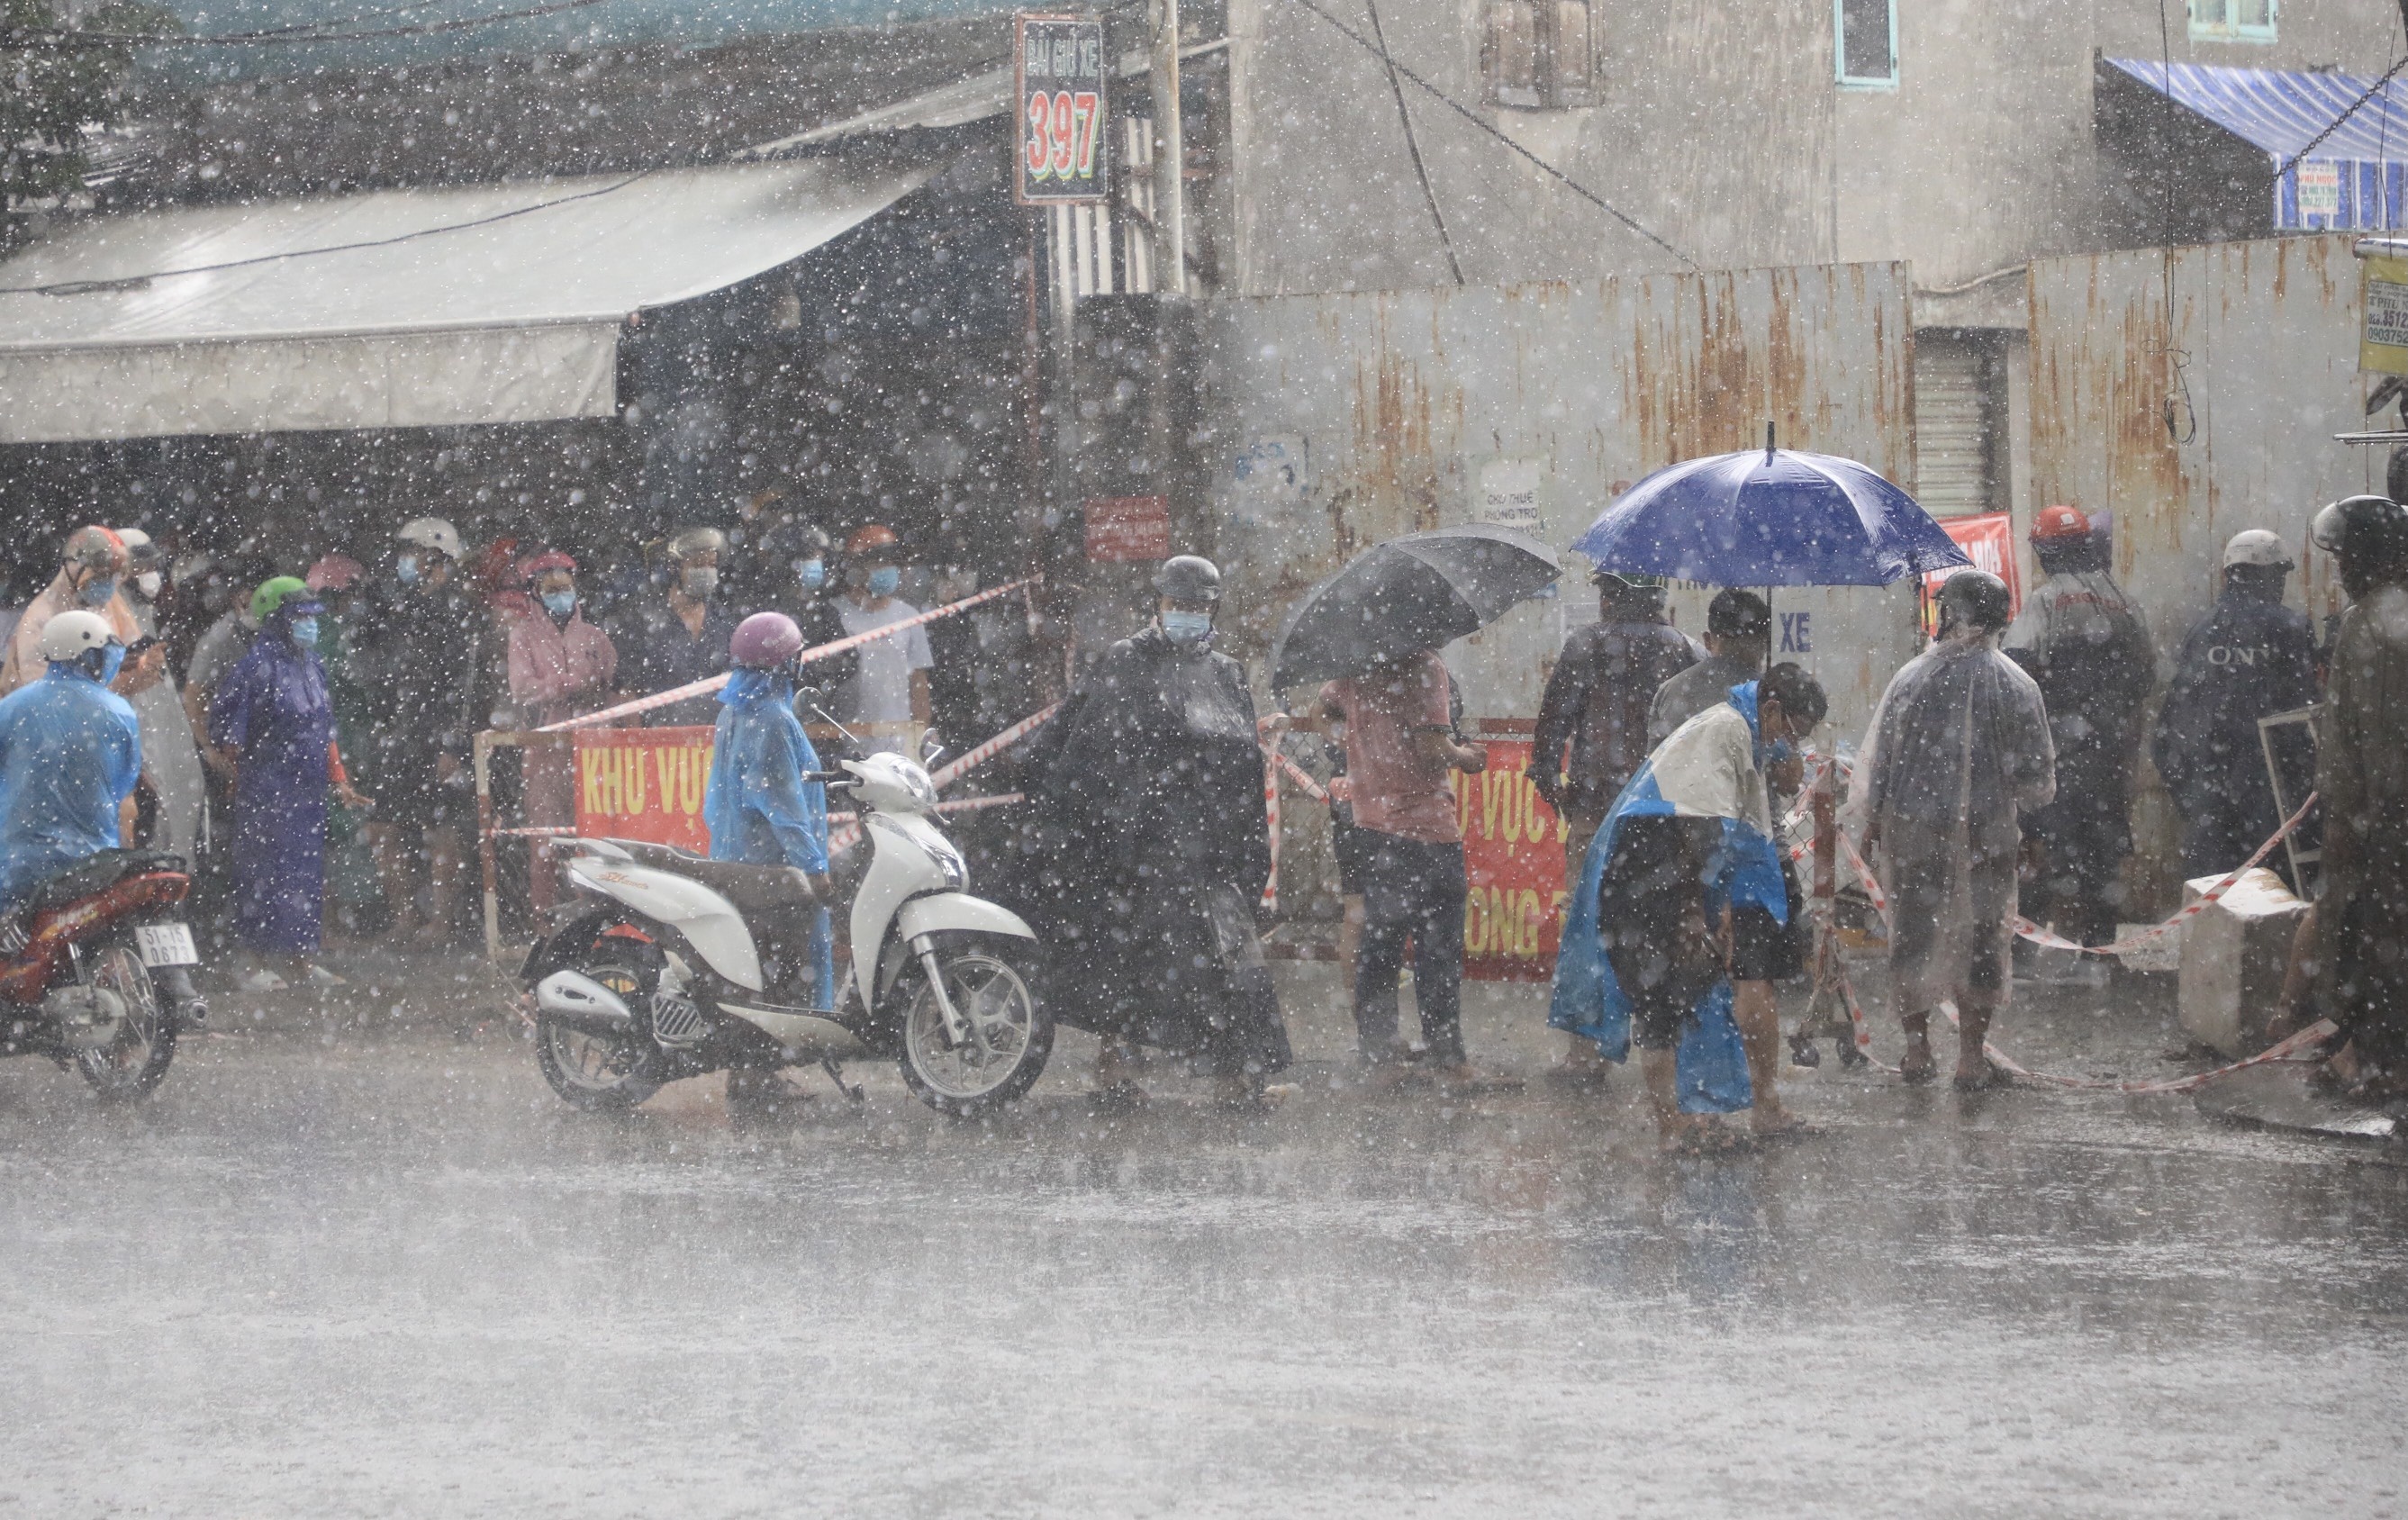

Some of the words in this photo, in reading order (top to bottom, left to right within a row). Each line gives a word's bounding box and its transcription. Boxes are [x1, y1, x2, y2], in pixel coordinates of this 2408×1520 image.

[1079, 40, 1098, 77] XE
[1027, 90, 1100, 180] 397
[1779, 612, 1812, 653] XE
[582, 746, 646, 815] KHU
